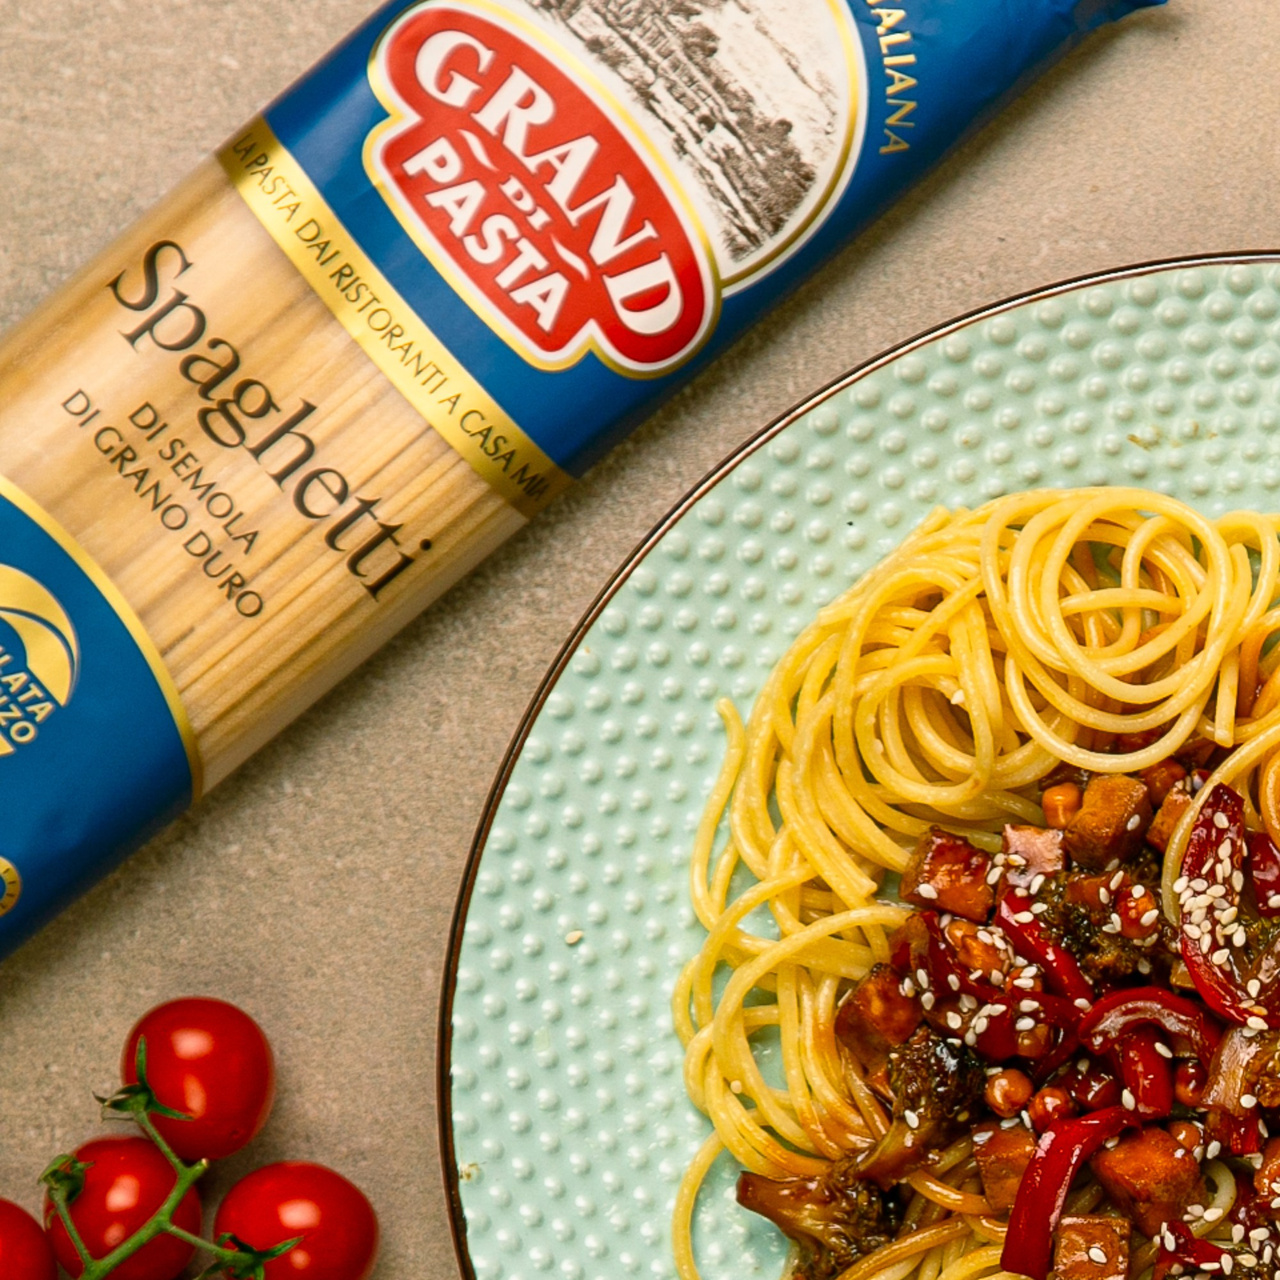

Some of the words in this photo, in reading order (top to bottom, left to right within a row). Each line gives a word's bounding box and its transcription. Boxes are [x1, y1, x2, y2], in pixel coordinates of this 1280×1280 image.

[414, 29, 685, 336] GRAND
[867, 0, 918, 155] ALIANA
[232, 132, 256, 162] LA
[245, 153, 302, 223] PASTA
[294, 217, 341, 267] DAI
[328, 262, 449, 395] RISTORANTI
[437, 392, 462, 415] A
[459, 409, 517, 473] CASA
[401, 137, 571, 333] PASTA
[499, 176, 553, 231] DI
[61, 388, 101, 428] DI
[93, 425, 190, 532] GRANO
[182, 528, 265, 619] DURO
[106, 239, 433, 603] Spaghetti
[127, 400, 169, 434] DI
[158, 437, 261, 556] SEMOLA
